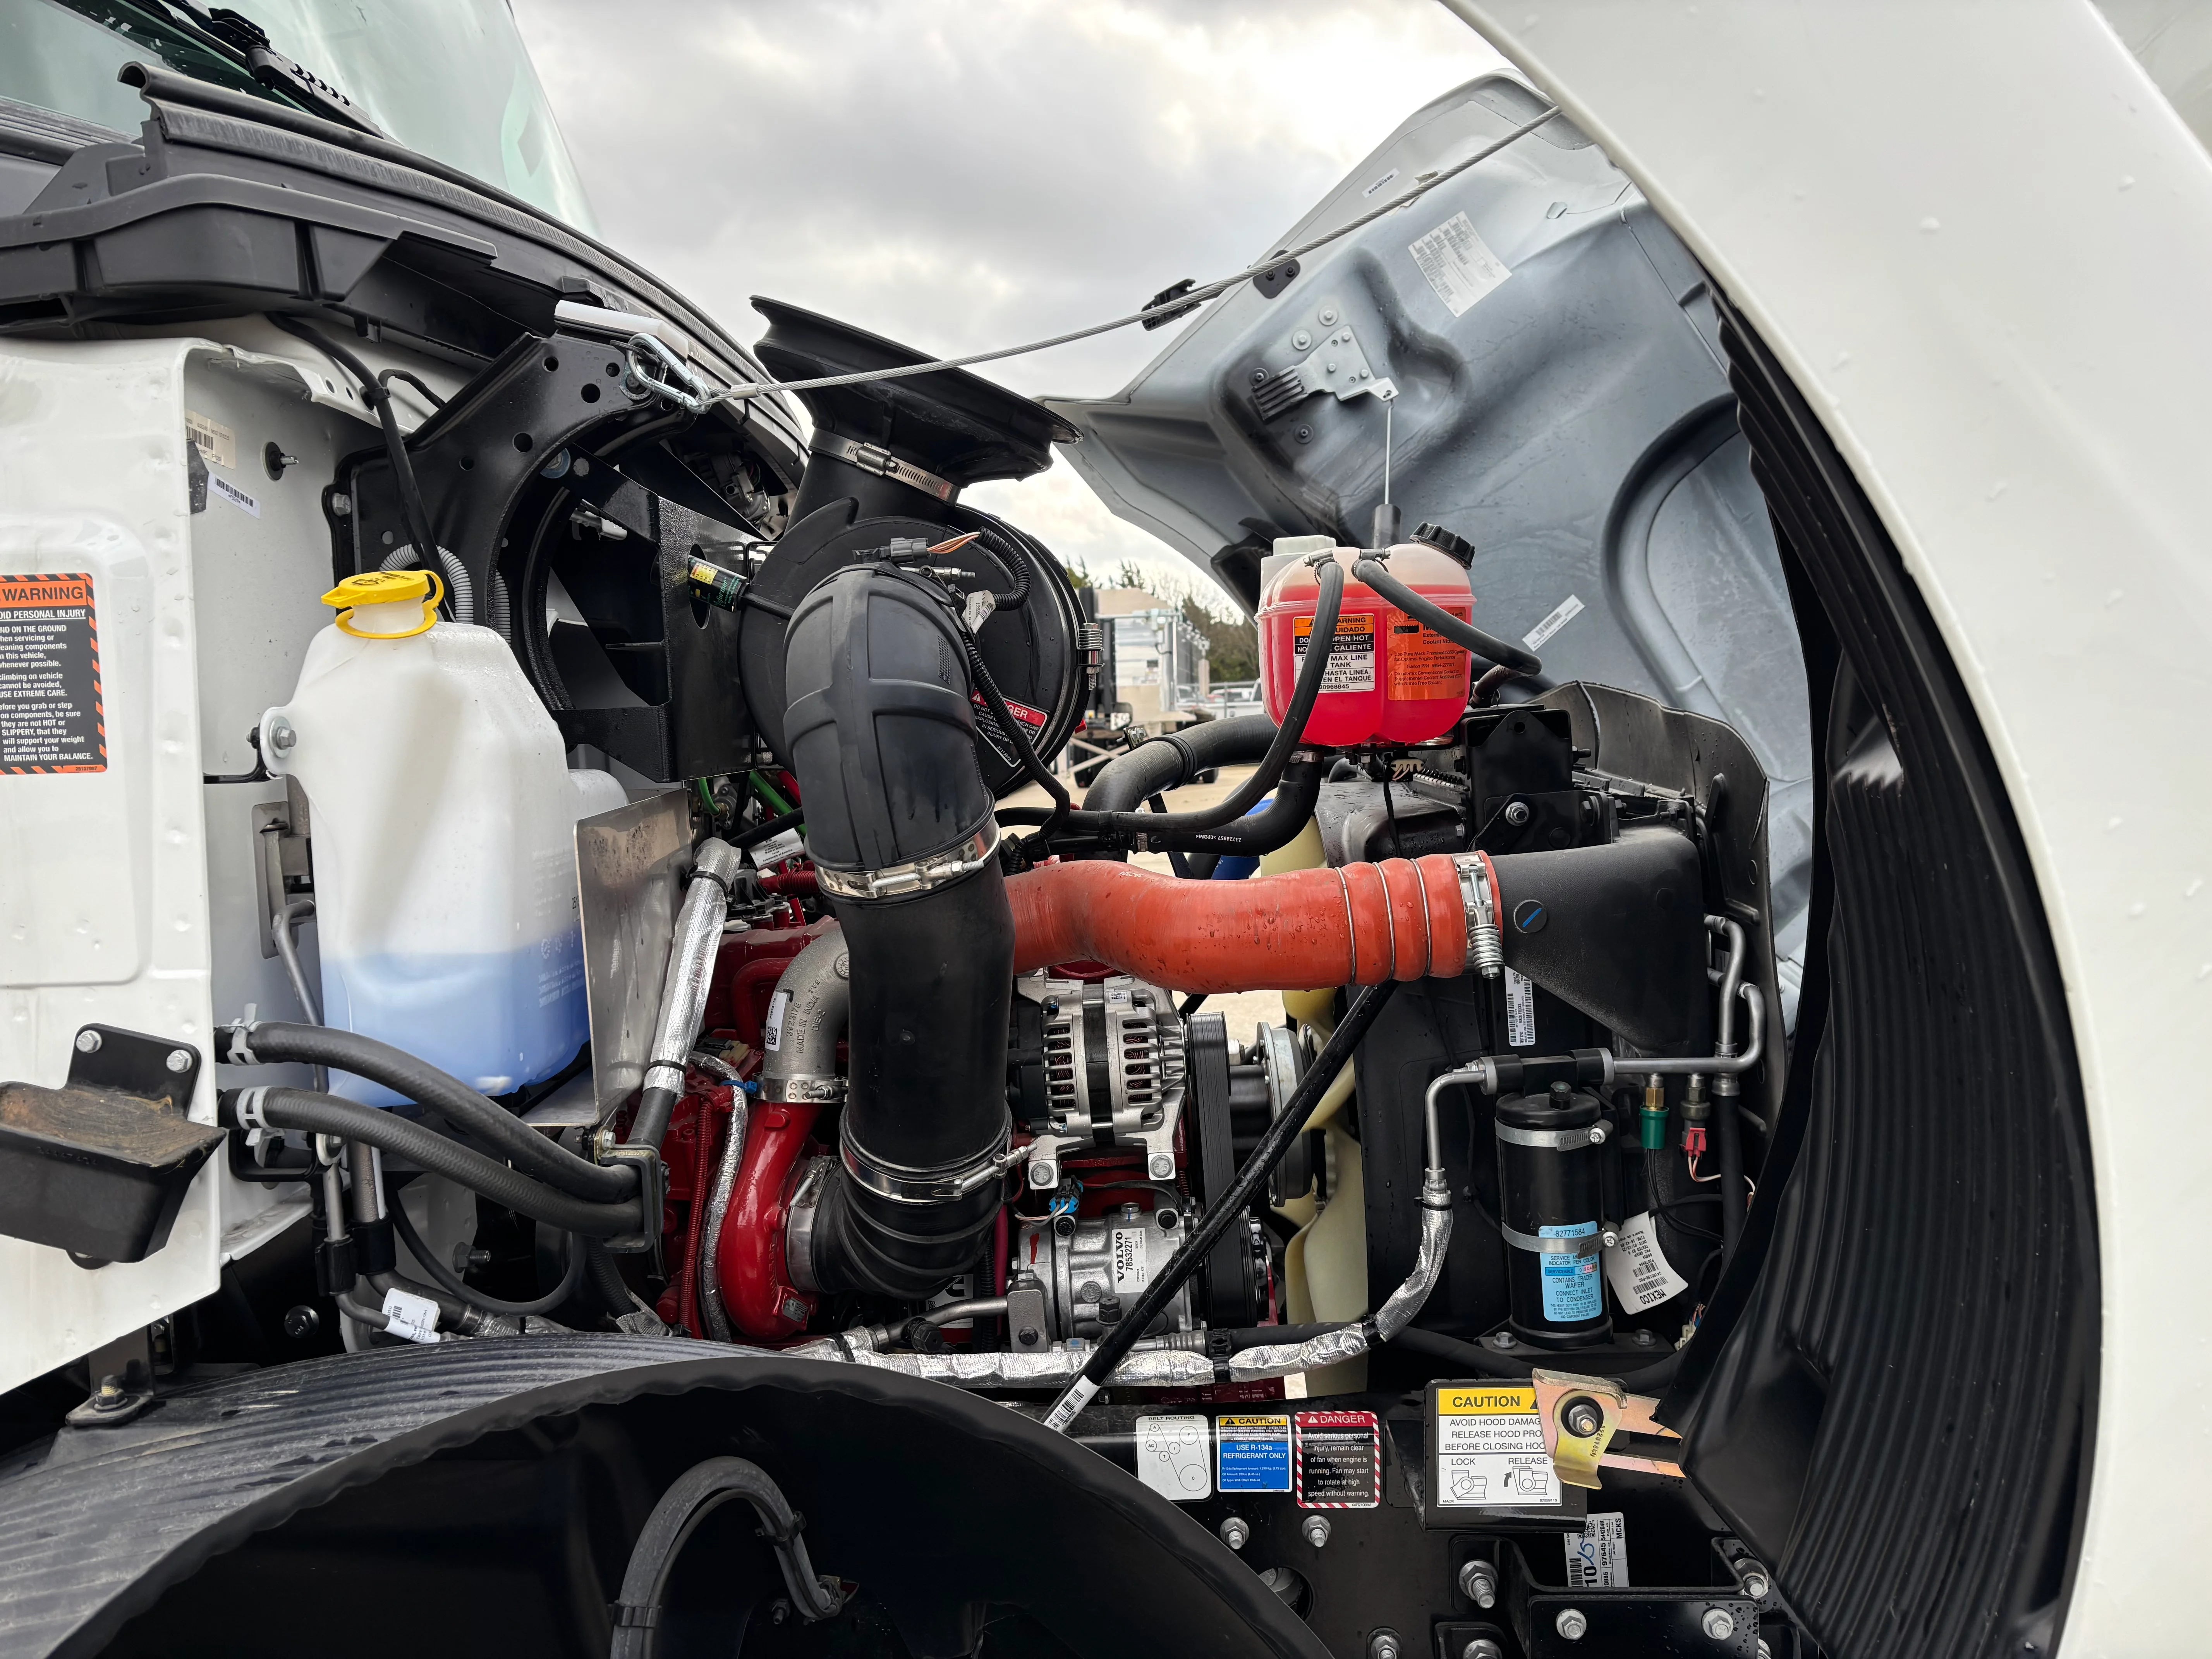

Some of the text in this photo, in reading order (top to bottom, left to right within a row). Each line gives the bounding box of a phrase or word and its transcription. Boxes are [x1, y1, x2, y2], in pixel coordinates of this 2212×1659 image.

[2, 586, 83, 601] WARNING
[14, 609, 86, 618] PERSONAL INJURY
[1008, 705, 1028, 719] GER
[987, 726, 1005, 735] SERIOUS
[987, 731, 1002, 739] INJURY
[796, 995, 820, 1053] MADE IN INDIA
[1555, 1228, 1585, 1237] 82771584
[1116, 1232, 1124, 1283] VOLVO
[1125, 1237, 1133, 1271] 78532271
[1567, 1294, 1593, 1302] CONDENSER
[1640, 1289, 1666, 1304] MEXICO
[1453, 1396, 1520, 1407] CAUTION
